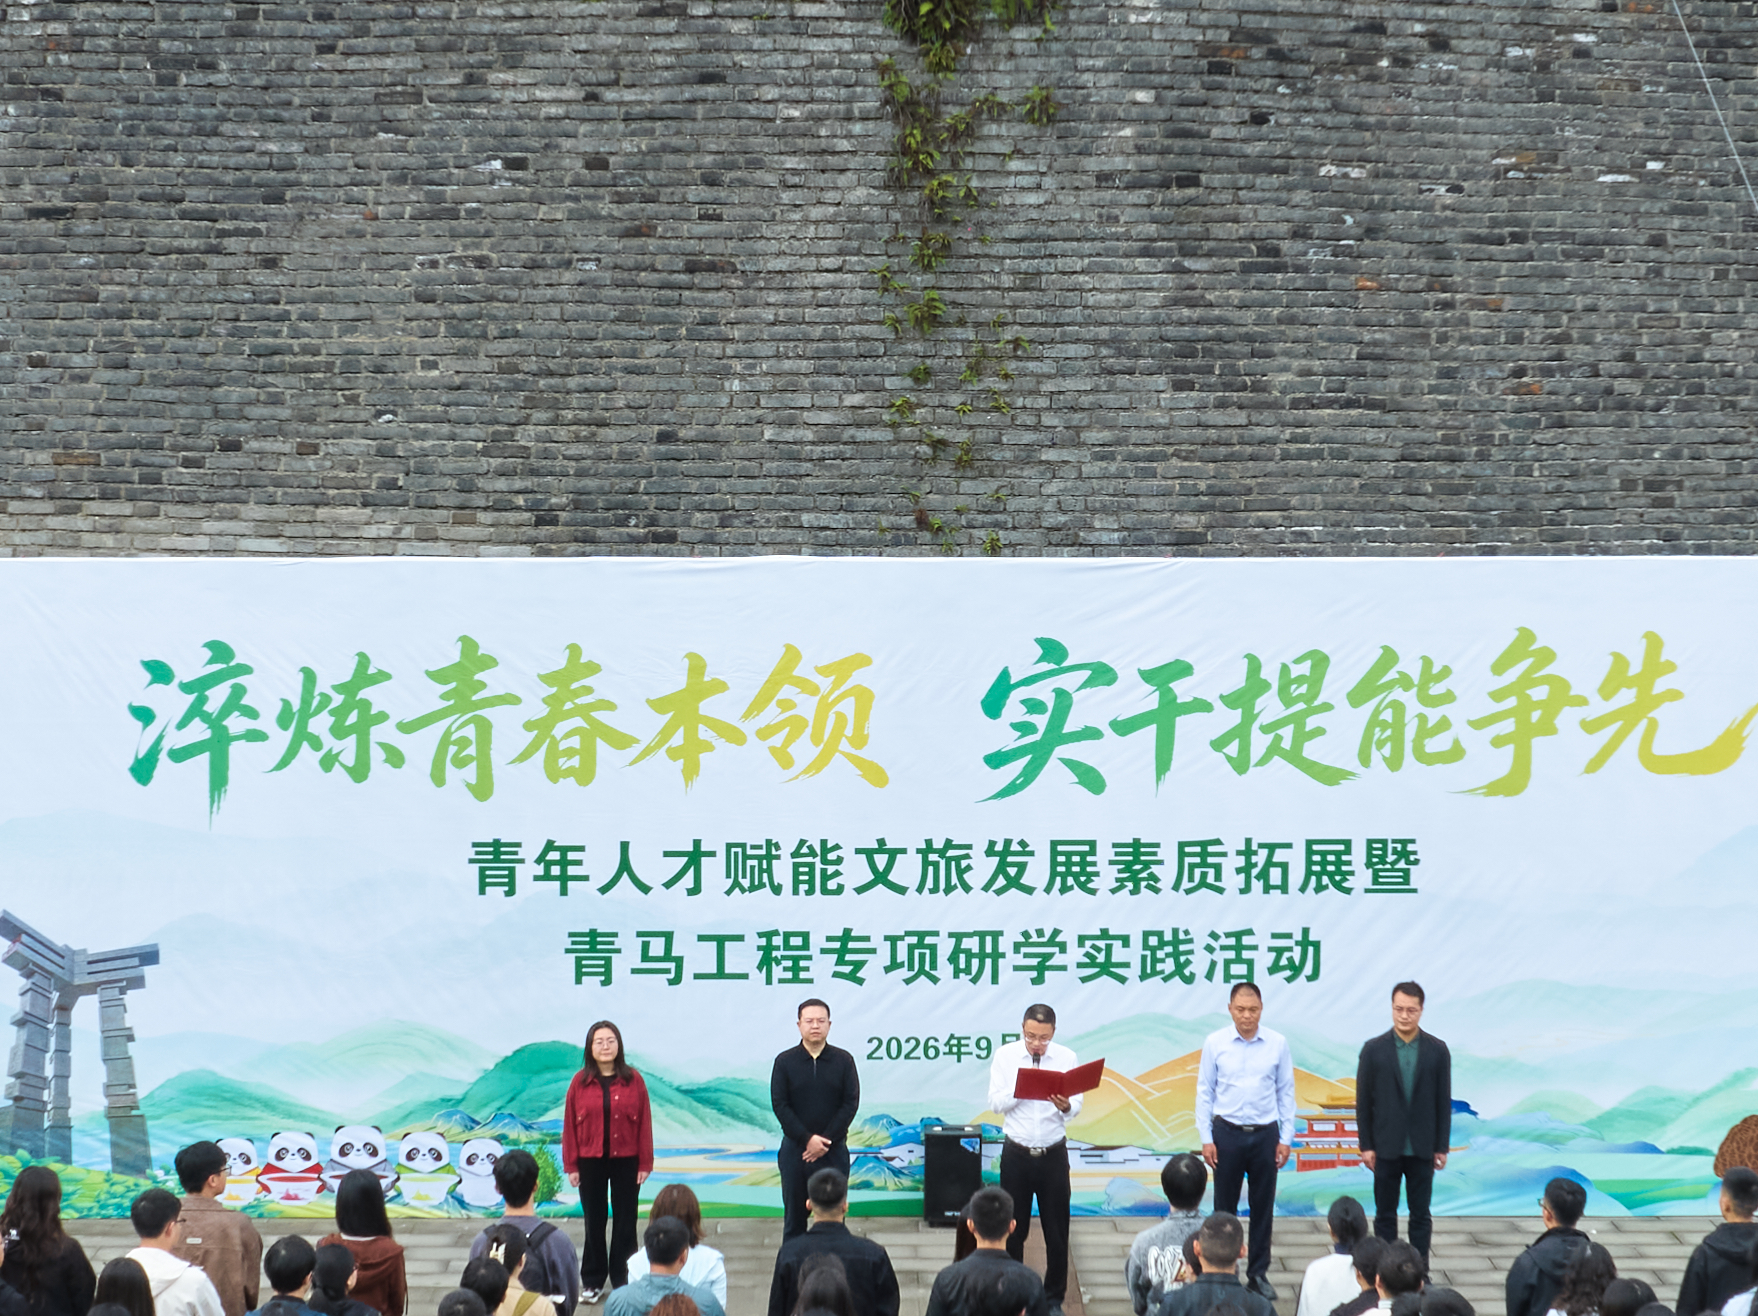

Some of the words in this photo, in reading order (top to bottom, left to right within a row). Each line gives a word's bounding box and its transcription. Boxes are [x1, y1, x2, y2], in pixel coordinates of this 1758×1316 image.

[127, 634, 891, 821] 淬炼青春本领
[468, 836, 1422, 897] 青年人才赋能文旅发展素质拓展暨
[564, 927, 1323, 986] 青马工程专项研学实践活动
